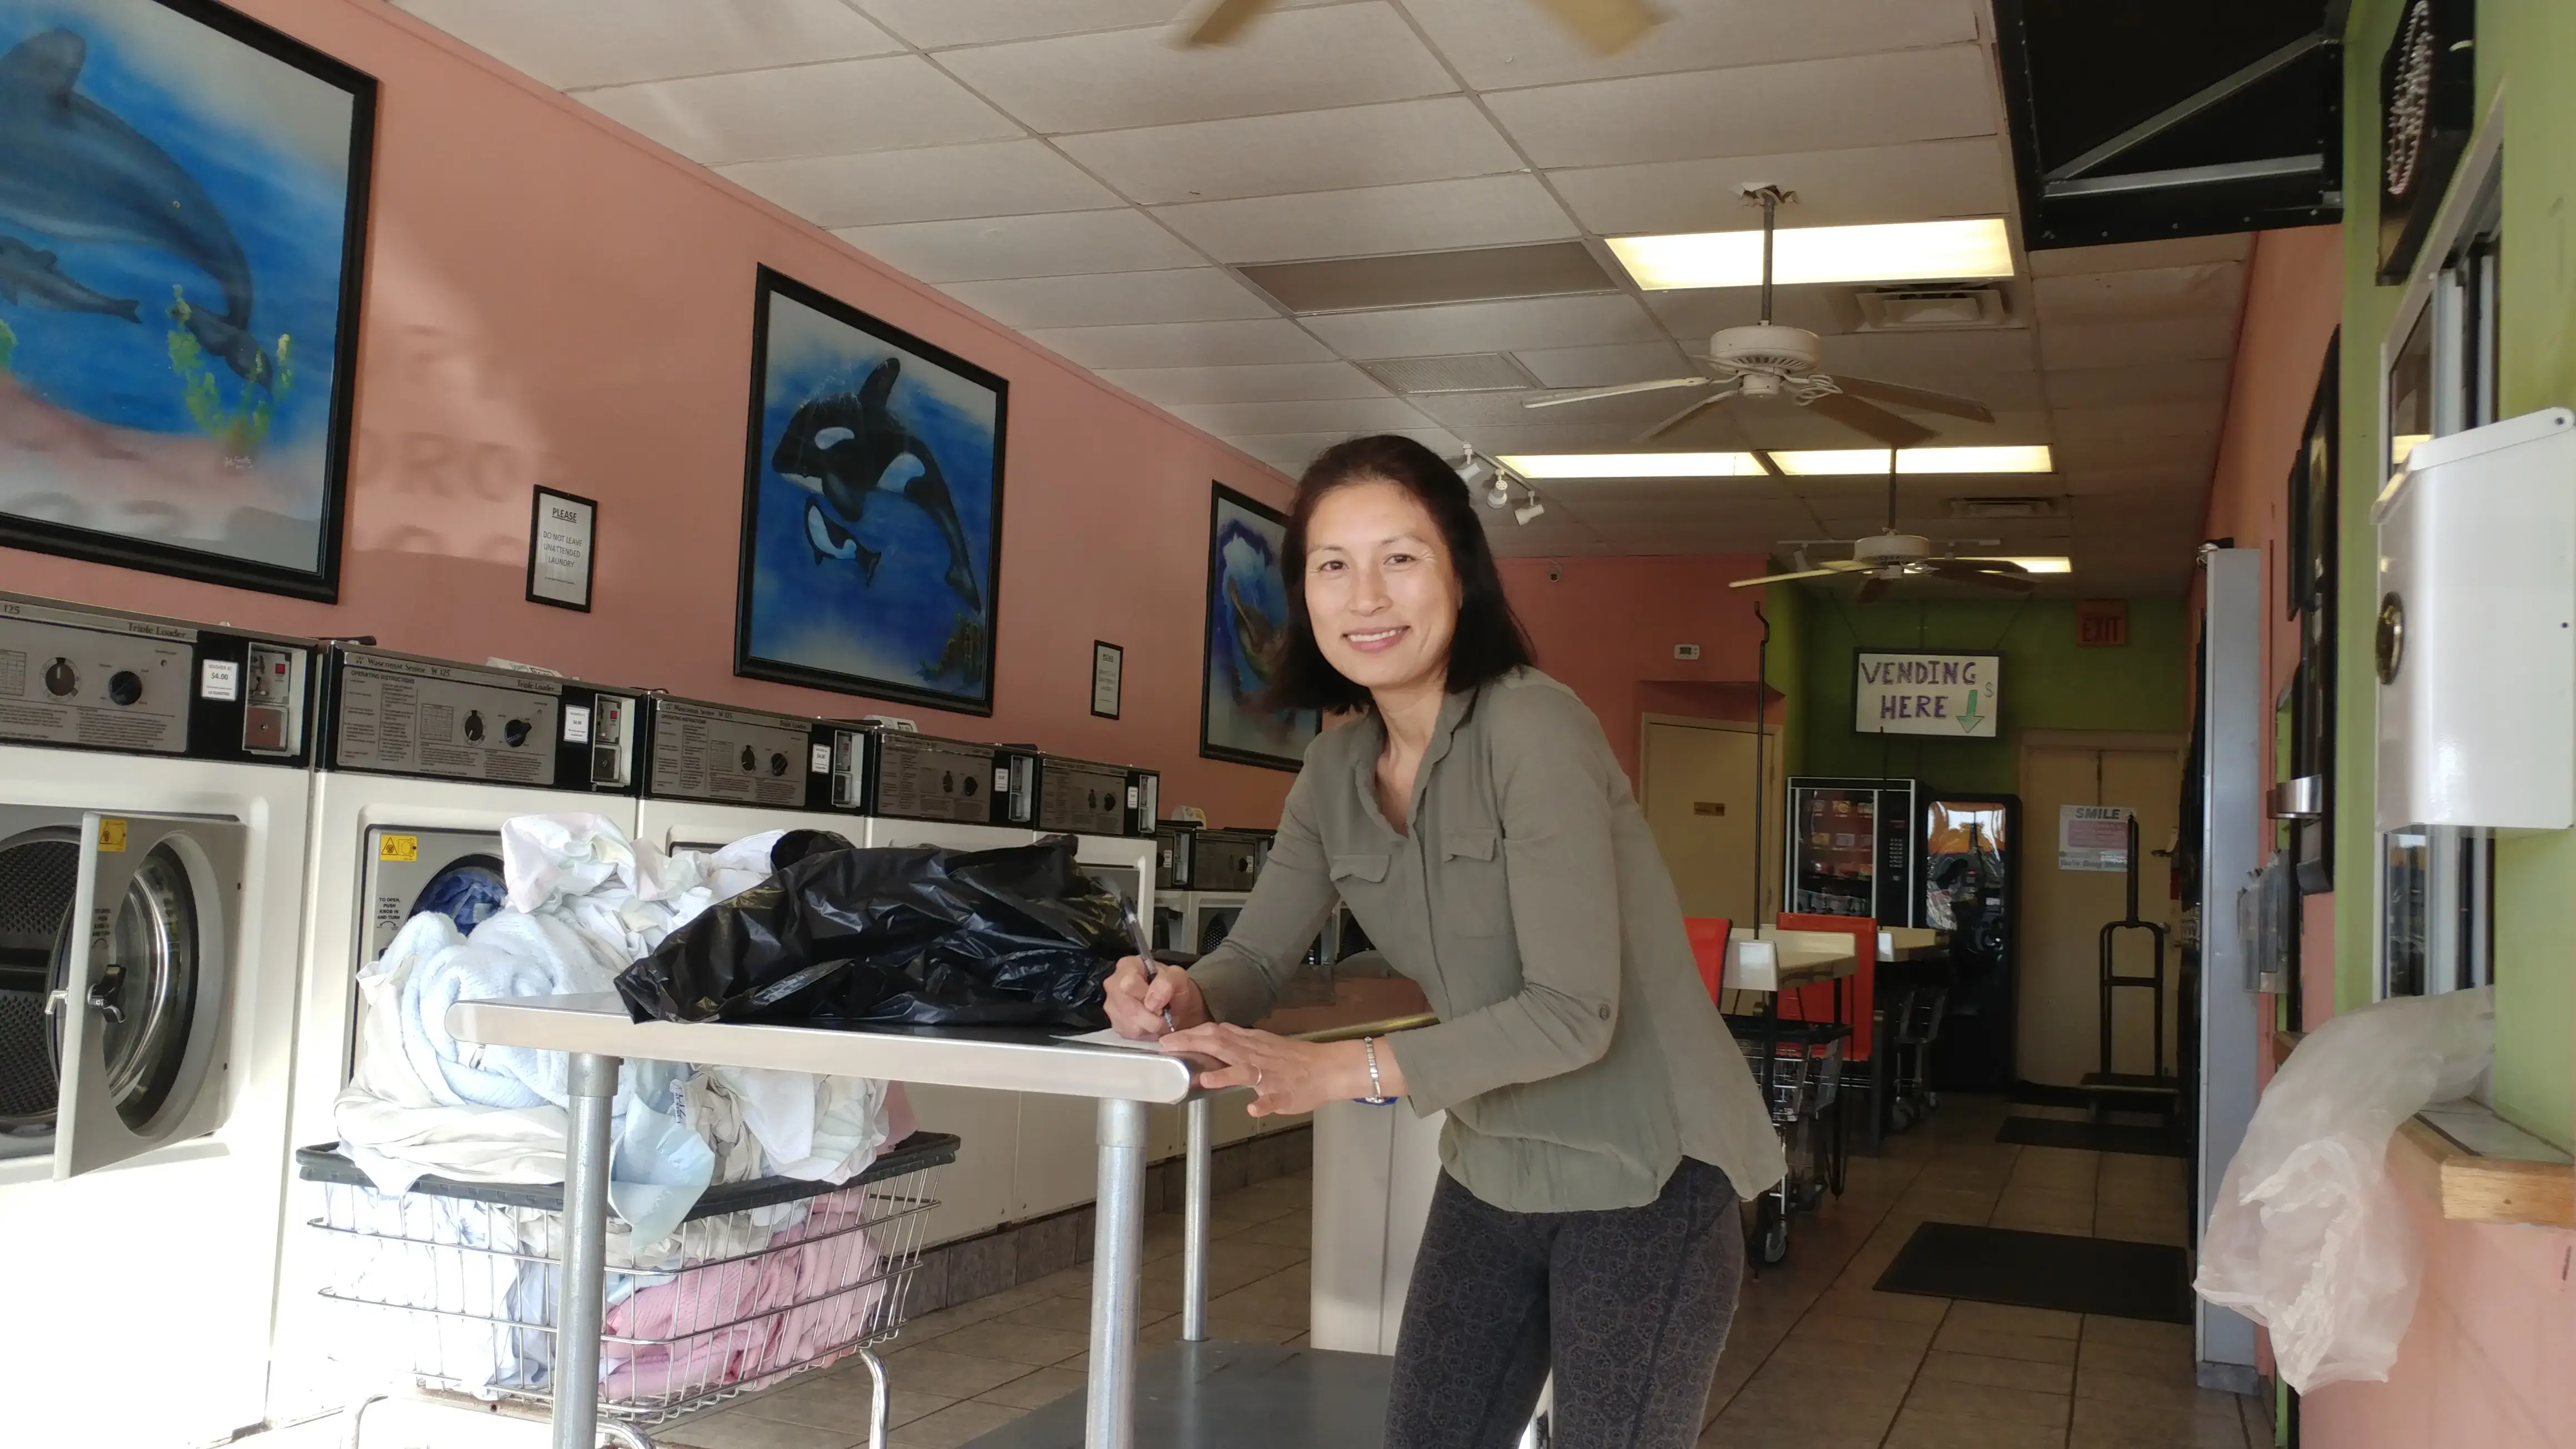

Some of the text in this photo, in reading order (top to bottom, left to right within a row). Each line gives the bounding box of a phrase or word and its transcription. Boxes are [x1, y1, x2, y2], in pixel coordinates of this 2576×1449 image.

[552, 507, 577, 521] PLEASE
[543, 531, 582, 547] DO NOT LEAVE
[544, 544, 581, 558] UNATTENDED
[549, 556, 575, 568] LAUNDRY
[3, 605, 20, 615] 125
[128, 622, 187, 638] Triple Loader
[2082, 616, 2121, 642] EXIT
[368, 658, 402, 670] Wascomat
[405, 664, 426, 673] Senior
[1861, 660, 1976, 685] VENDING
[211, 671, 229, 680] $4.00
[351, 671, 415, 684] OPERATING INSTRUCTIONS
[1880, 695, 1949, 719] HERE
[2075, 808, 2120, 819] SMILE
